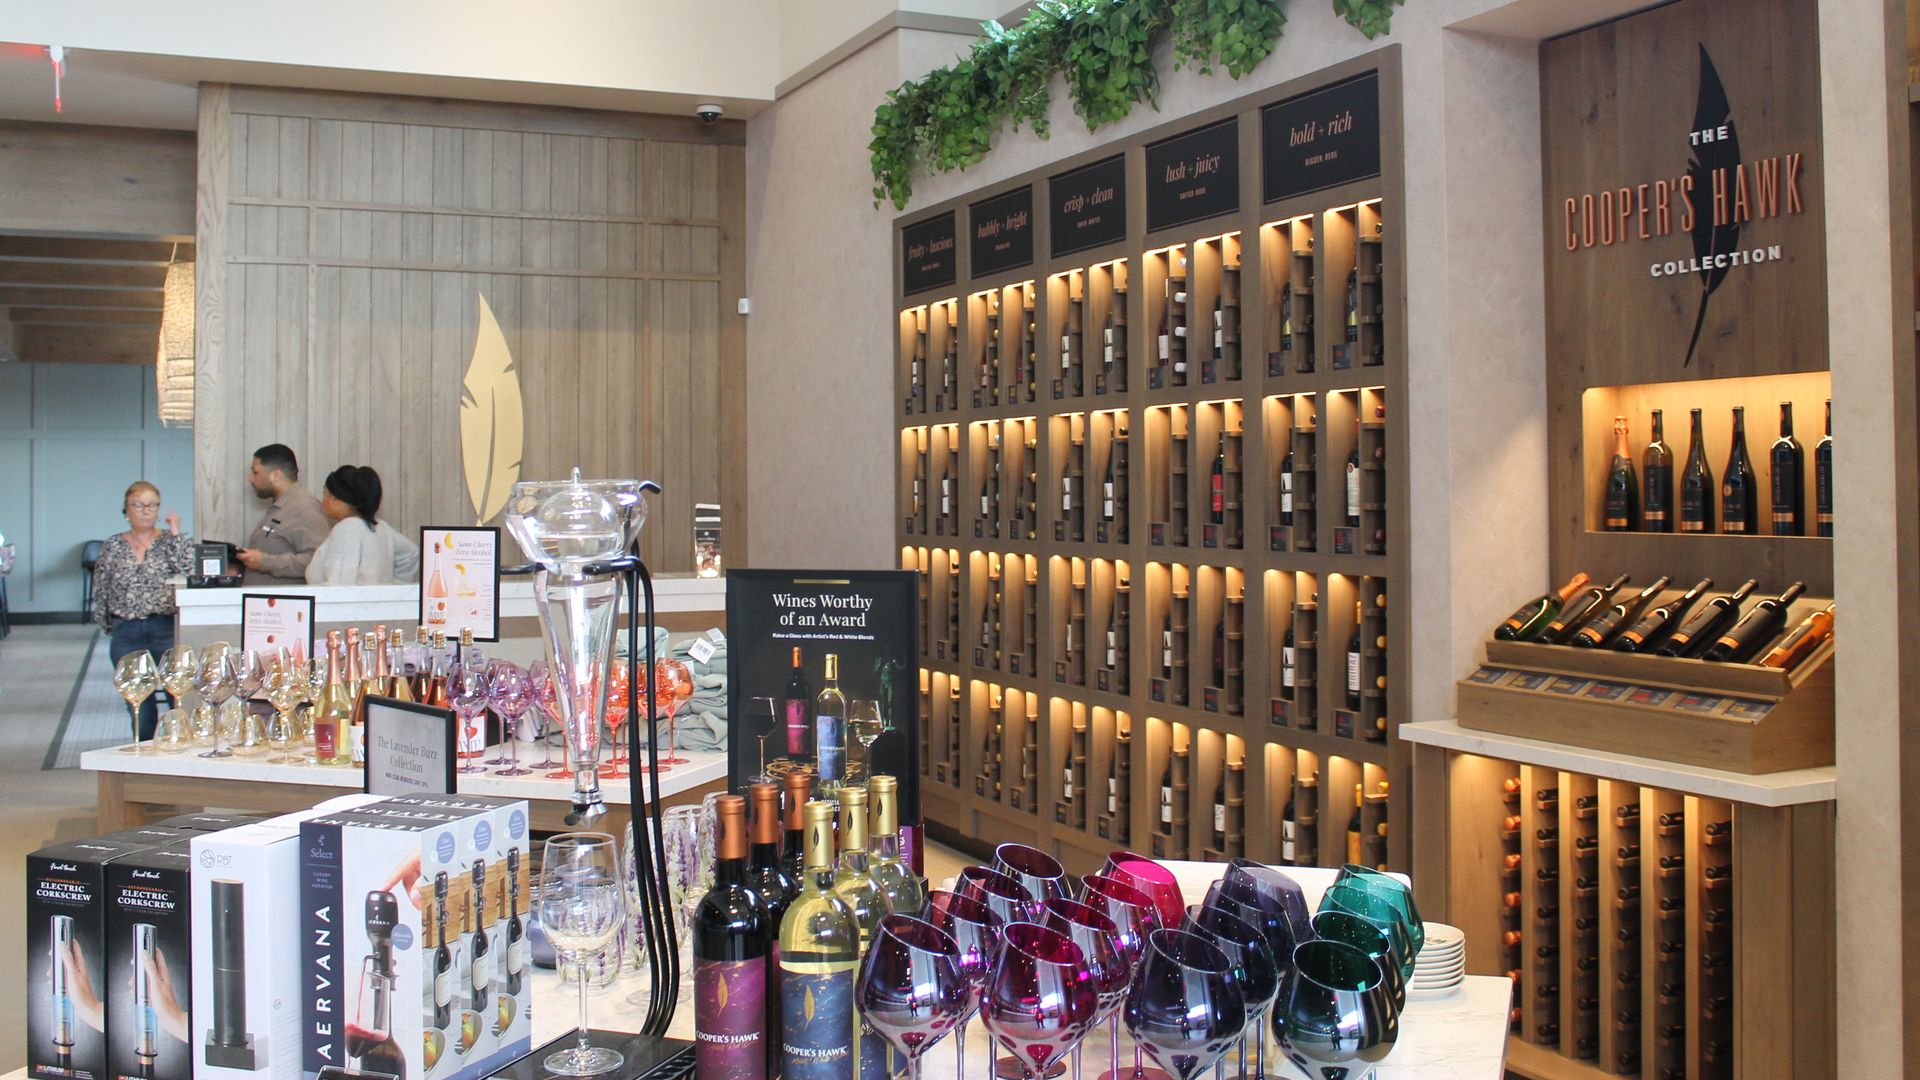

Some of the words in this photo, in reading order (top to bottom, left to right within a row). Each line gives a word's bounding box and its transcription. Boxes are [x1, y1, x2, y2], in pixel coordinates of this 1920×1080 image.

[1290, 121, 1316, 147] bold
[1328, 110, 1352, 136] rich
[1690, 126, 1729, 146] THE
[1166, 161, 1186, 183] lush
[1194, 154, 1220, 179] juicy
[1064, 194, 1084, 213] crisp
[1091, 187, 1114, 205] clean
[1564, 174, 1696, 251] COOPER'S
[1712, 152, 1804, 226] HAWK
[1006, 212, 1027, 230] bright
[1650, 245, 1783, 277] COLLECTION
[772, 593, 816, 608] Wines
[820, 594, 873, 611] Worthy
[780, 612, 795, 626] of
[798, 616, 815, 626] an
[819, 612, 866, 627] Award
[377, 736, 389, 748] The
[390, 739, 420, 756] Lavender
[421, 746, 438, 760] Buzz
[390, 755, 424, 774] Collection
[391, 797, 499, 810] AERVANA
[353, 807, 463, 820] AERVANA
[312, 818, 425, 832] AERVANA
[310, 848, 334, 859] Select
[36, 889, 92, 902] CORKSCREW
[41, 882, 85, 893] ELECTRIC
[122, 889, 169, 900] ELECTRIC
[118, 897, 176, 910] CORKSCREW
[315, 906, 332, 1060] AERVANA
[696, 1030, 729, 1044] COOPER'S
[731, 1032, 760, 1043] HAWK
[783, 1042, 816, 1057] COOPER'S
[818, 1046, 848, 1058] HAWK
